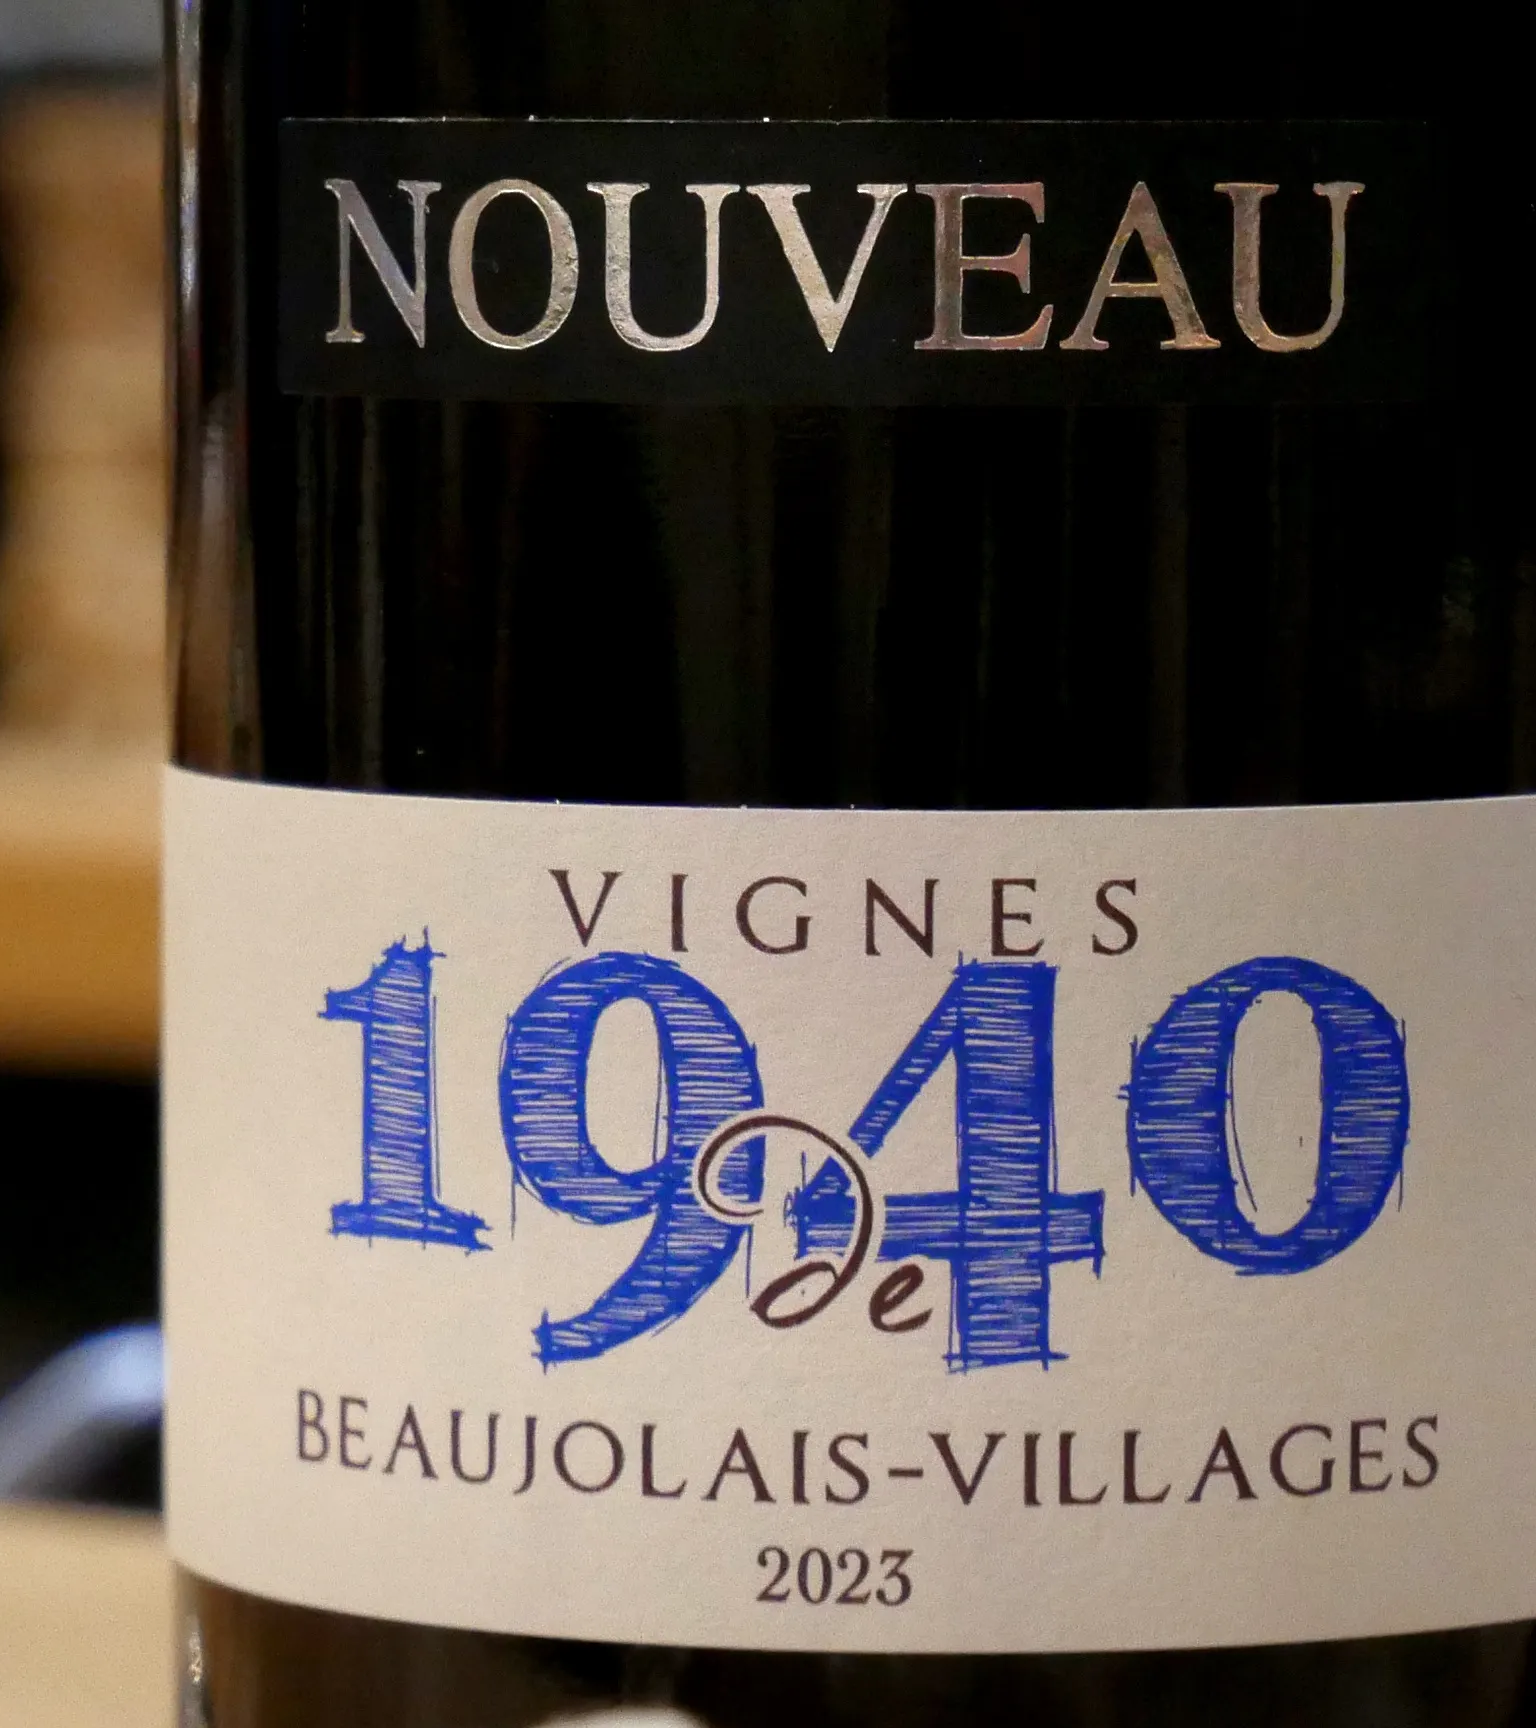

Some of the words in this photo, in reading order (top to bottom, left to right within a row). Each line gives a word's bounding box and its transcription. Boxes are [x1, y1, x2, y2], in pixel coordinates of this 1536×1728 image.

[322, 177, 1367, 353] NOUVEAU
[549, 868, 1142, 958] VIGNES
[314, 924, 1412, 1374] 1940
[696, 1114, 934, 1335] de
[296, 1388, 1443, 1507] BEAUJOLAIS-VILLAGES
[755, 1547, 913, 1606] 2023
